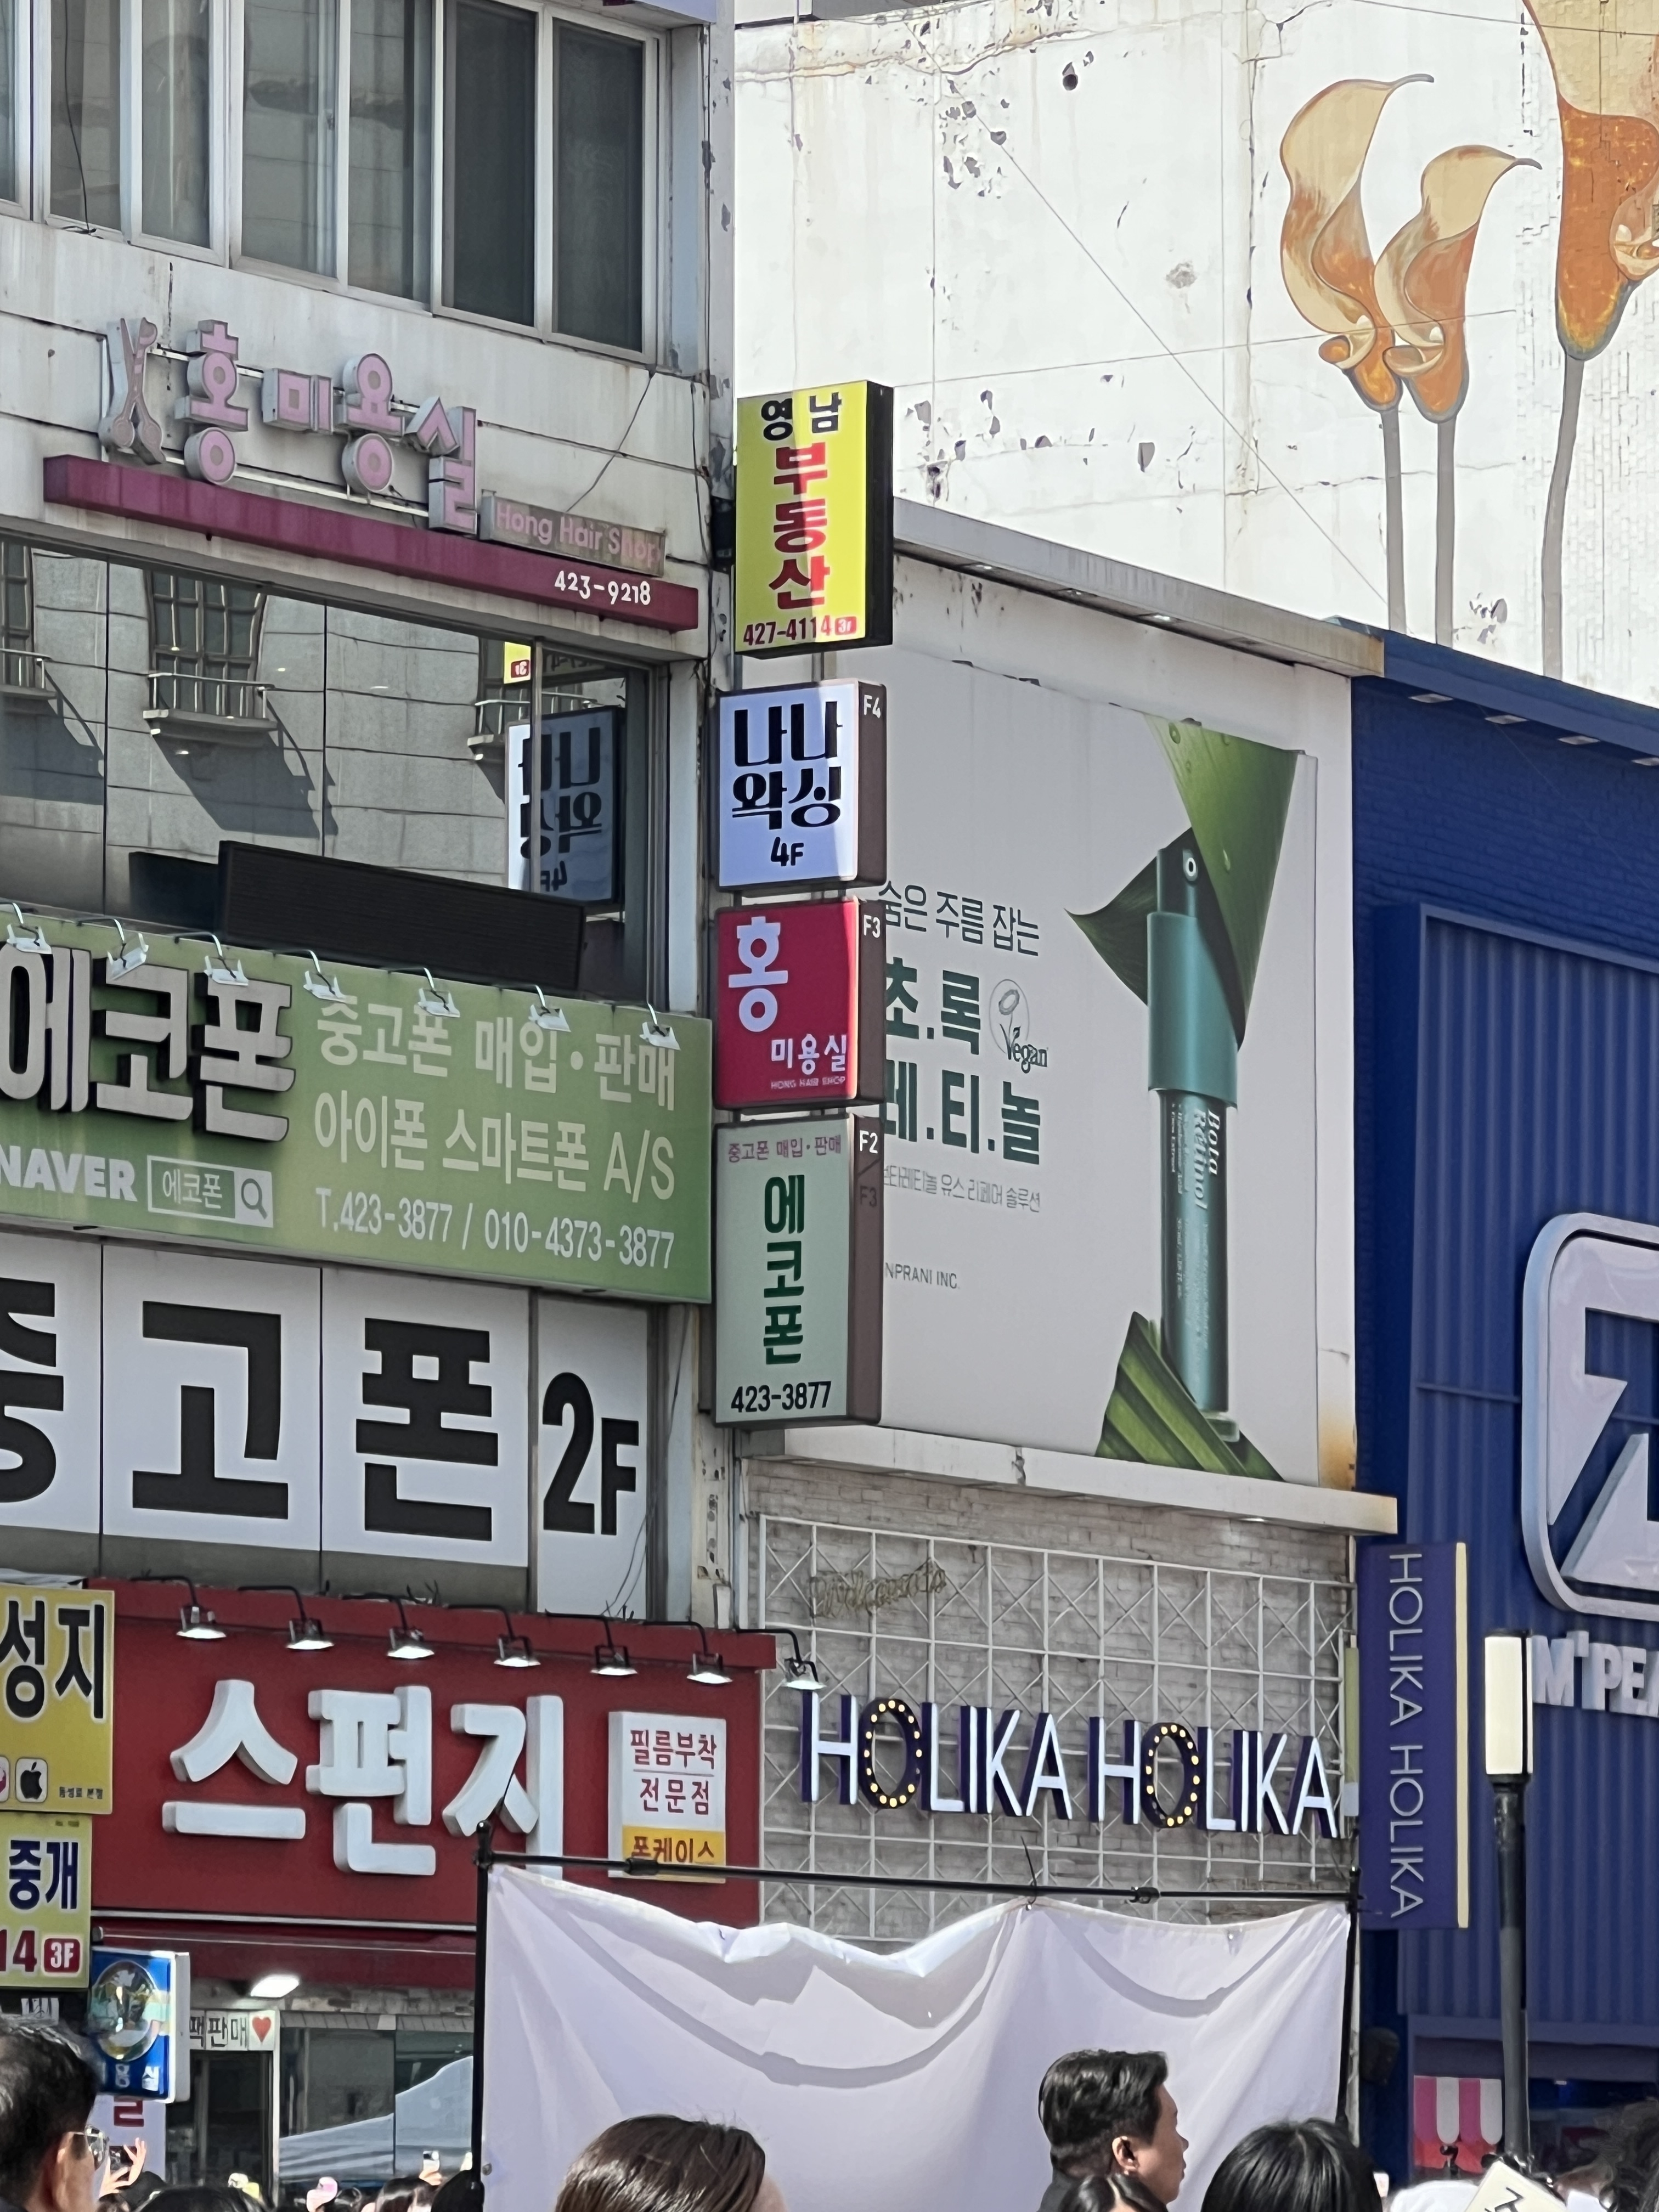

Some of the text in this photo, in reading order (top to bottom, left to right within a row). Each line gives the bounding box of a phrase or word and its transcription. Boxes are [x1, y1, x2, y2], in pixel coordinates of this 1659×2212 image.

[496, 501, 660, 568] Hong Hair Shop
[769, 442, 830, 610] 부동산
[555, 571, 651, 605] 423-9218
[743, 614, 831, 646] 427-4114
[735, 701, 843, 767] 나나
[864, 695, 881, 719] F4
[732, 766, 841, 830] 왁싱
[770, 837, 804, 867] 4F
[863, 915, 881, 938] F3
[879, 881, 1040, 957] 숨은 주름 잡는
[729, 916, 788, 1032] 홍
[0, 942, 296, 1142] 에코폰
[317, 996, 452, 1077] 중고폰
[771, 1034, 847, 1075] 미용실
[1000, 1023, 1048, 1074] Vegan
[314, 1090, 675, 1203] 아이폰 스마트폰 A/S
[728, 1141, 769, 1163] 중고폰
[859, 1130, 878, 1154] F2
[0, 1144, 138, 1203] NAVER
[162, 1169, 223, 1209] 에코폰
[484, 1208, 675, 1269] 010-4373-3877
[763, 1174, 805, 1365] 에코폰
[731, 1381, 832, 1413] 423-3877
[541, 1372, 639, 1536] 2F
[0, 1600, 104, 1719] 성지
[630, 1729, 717, 1770] 필름부착
[801, 1690, 1339, 1839] HOLIKA HOLIKA
[1389, 1553, 1424, 1918] HOLIKA HOLIKA
[162, 1679, 564, 1881] 스펀지
[640, 1778, 709, 1815] 전문점
[9, 1839, 78, 1910] 중개
[51, 1942, 74, 1969] 3F
